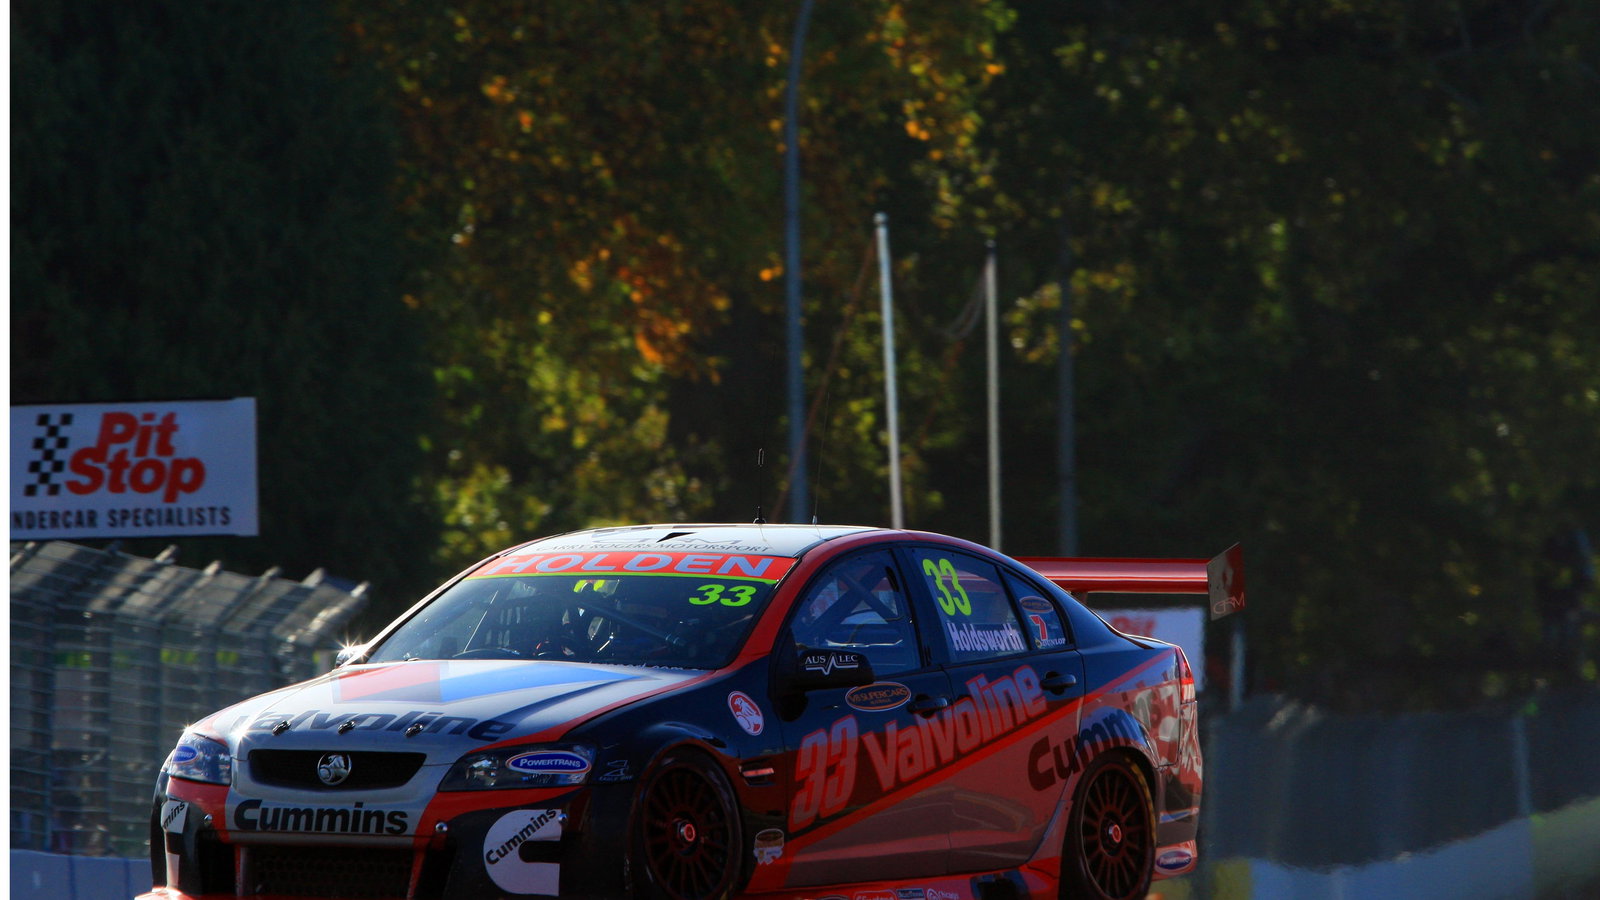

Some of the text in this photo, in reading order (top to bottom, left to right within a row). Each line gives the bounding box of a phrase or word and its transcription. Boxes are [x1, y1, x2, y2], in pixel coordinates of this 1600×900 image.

[98, 412, 178, 457] Pit
[65, 447, 206, 503] Stop
[12, 507, 231, 529] NDERCAR SPECIALISTS
[487, 552, 774, 577] HOLDEN
[688, 584, 757, 607] 33
[922, 558, 972, 616] 33
[947, 622, 1024, 652] Holdsworth
[861, 665, 1046, 792] Valvoline
[519, 758, 581, 768] POWERTRANS
[787, 714, 859, 834] 33
[234, 799, 408, 834] Cummins
[485, 807, 557, 865] Cummins
